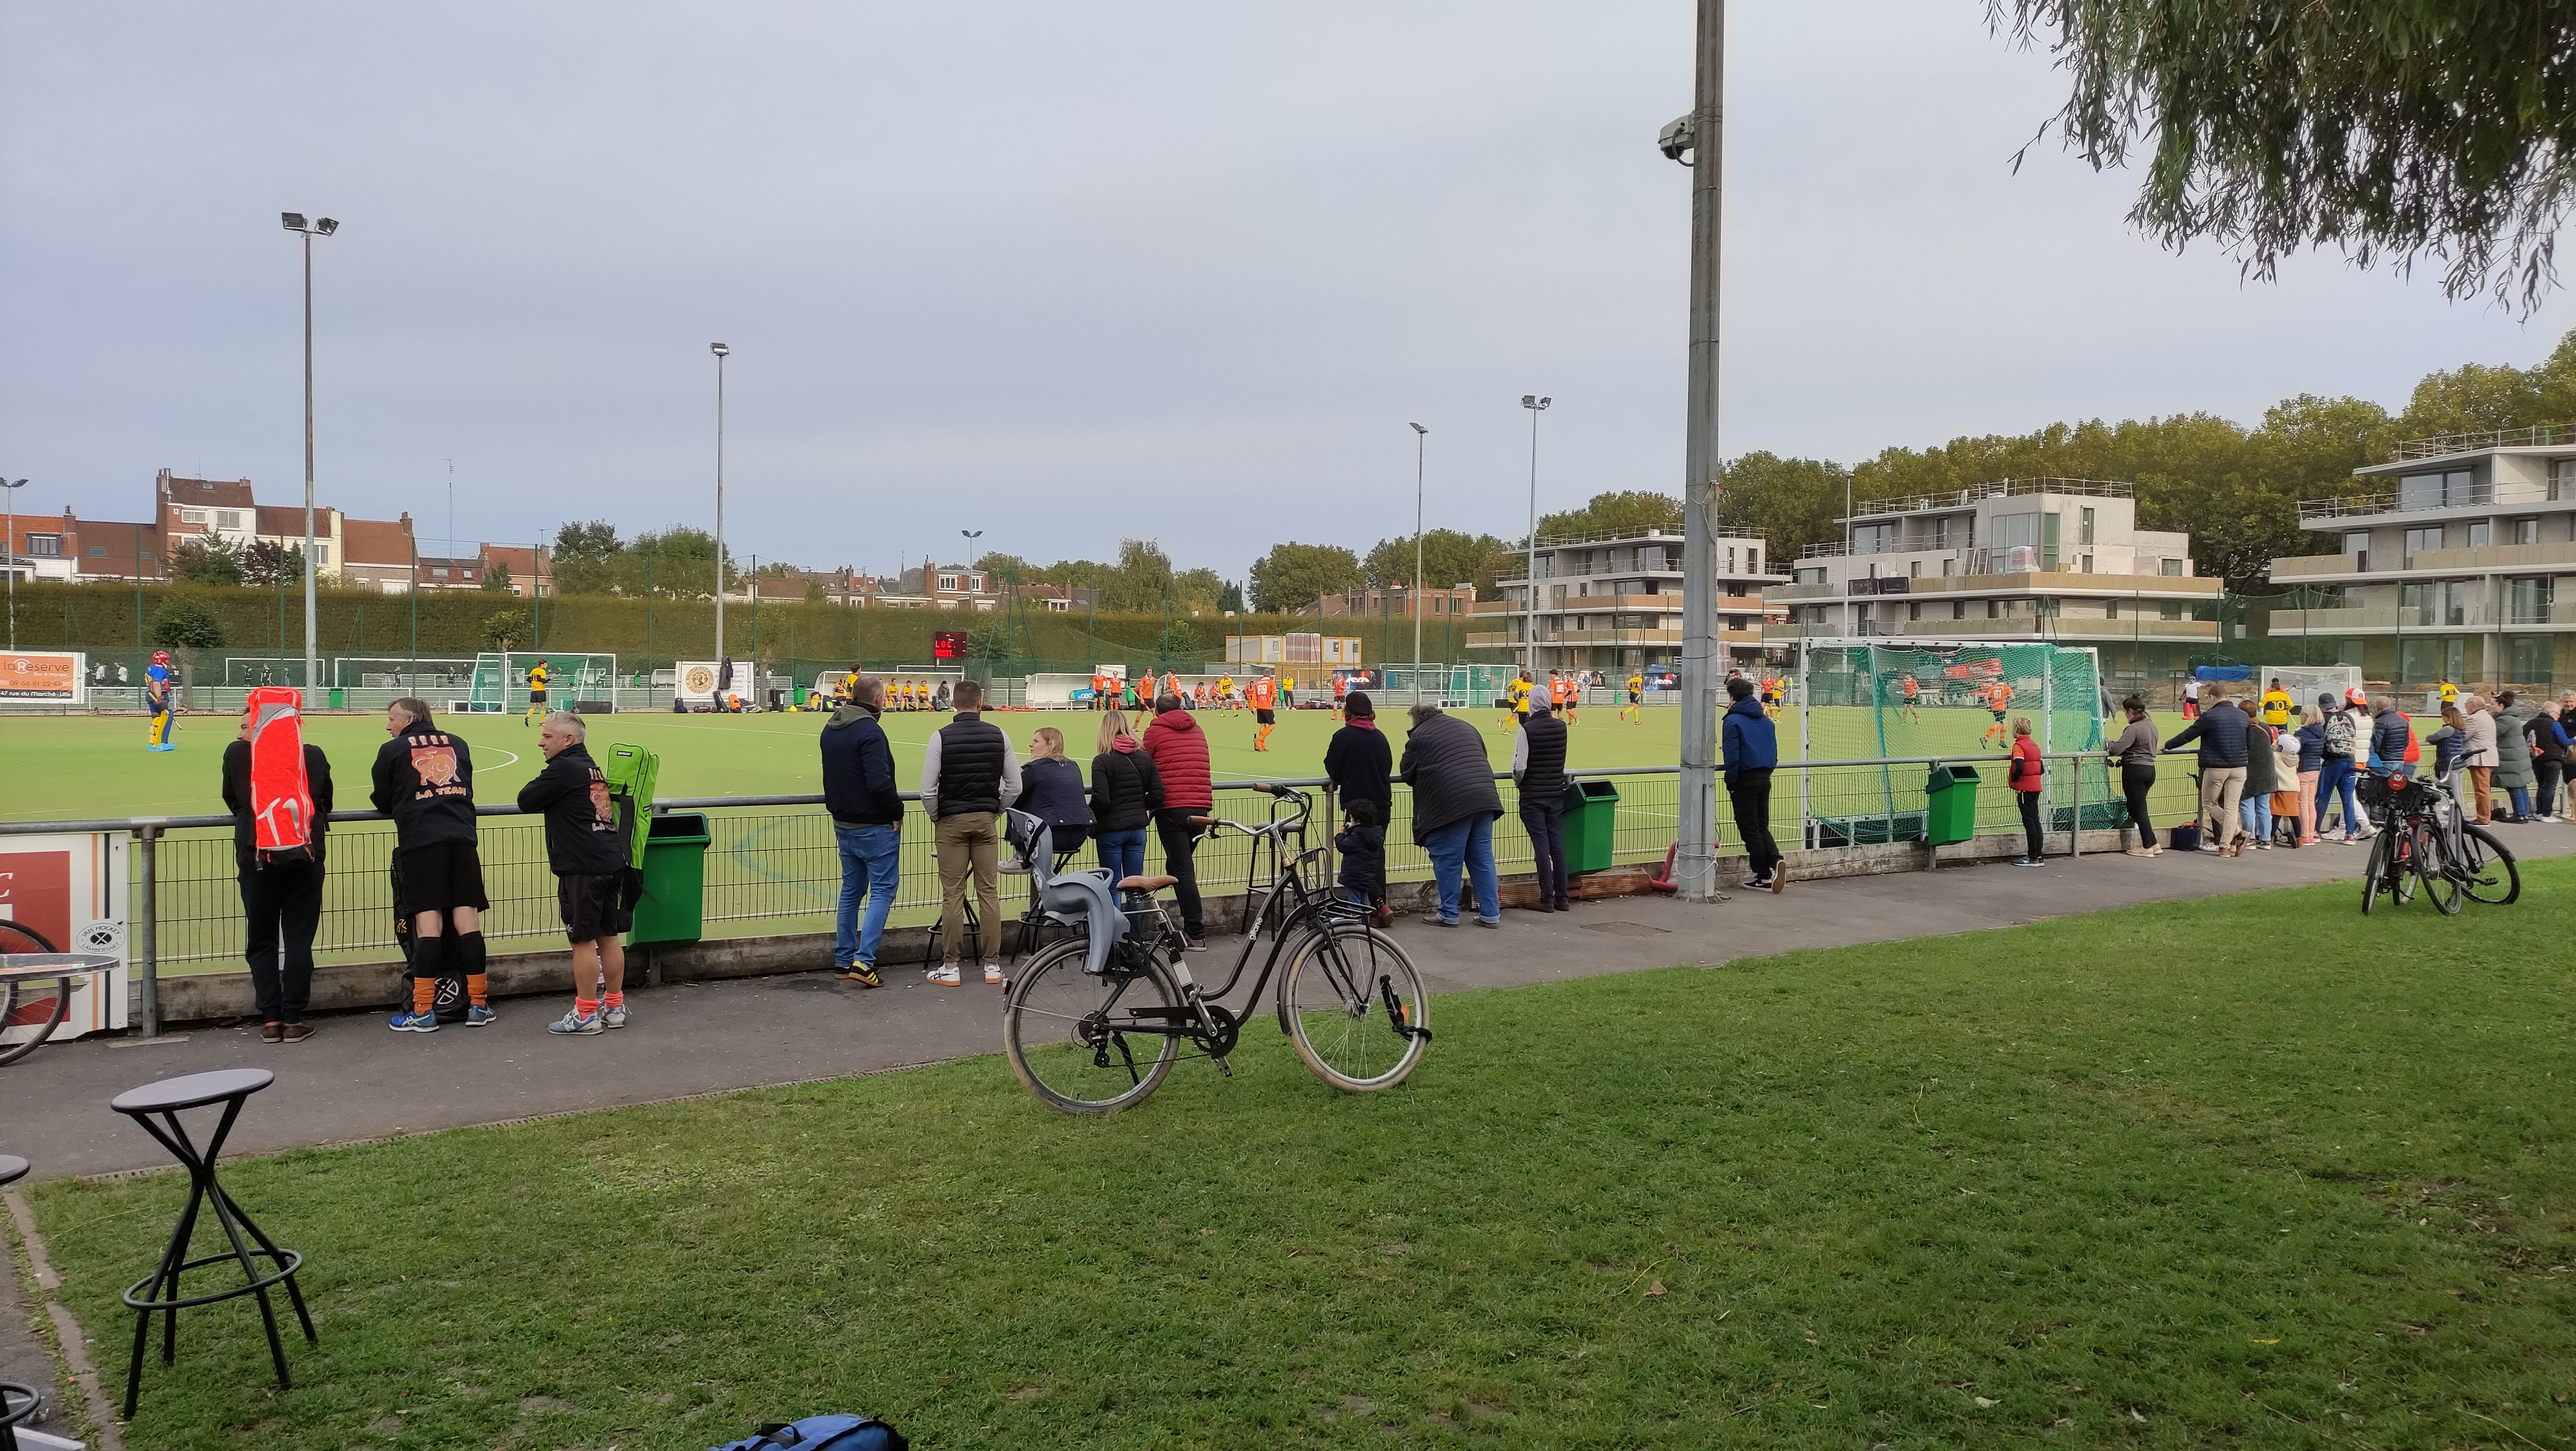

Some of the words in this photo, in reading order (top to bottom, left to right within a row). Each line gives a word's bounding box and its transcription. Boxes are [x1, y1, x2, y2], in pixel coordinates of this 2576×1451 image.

[2271, 700, 2285, 710] 10
[415, 790, 433, 800] LA
[435, 786, 466, 796] TEAM
[81, 927, 94, 937] IRIS
[95, 926, 122, 935] HOCKEY
[82, 941, 120, 952] LAMBERSART
